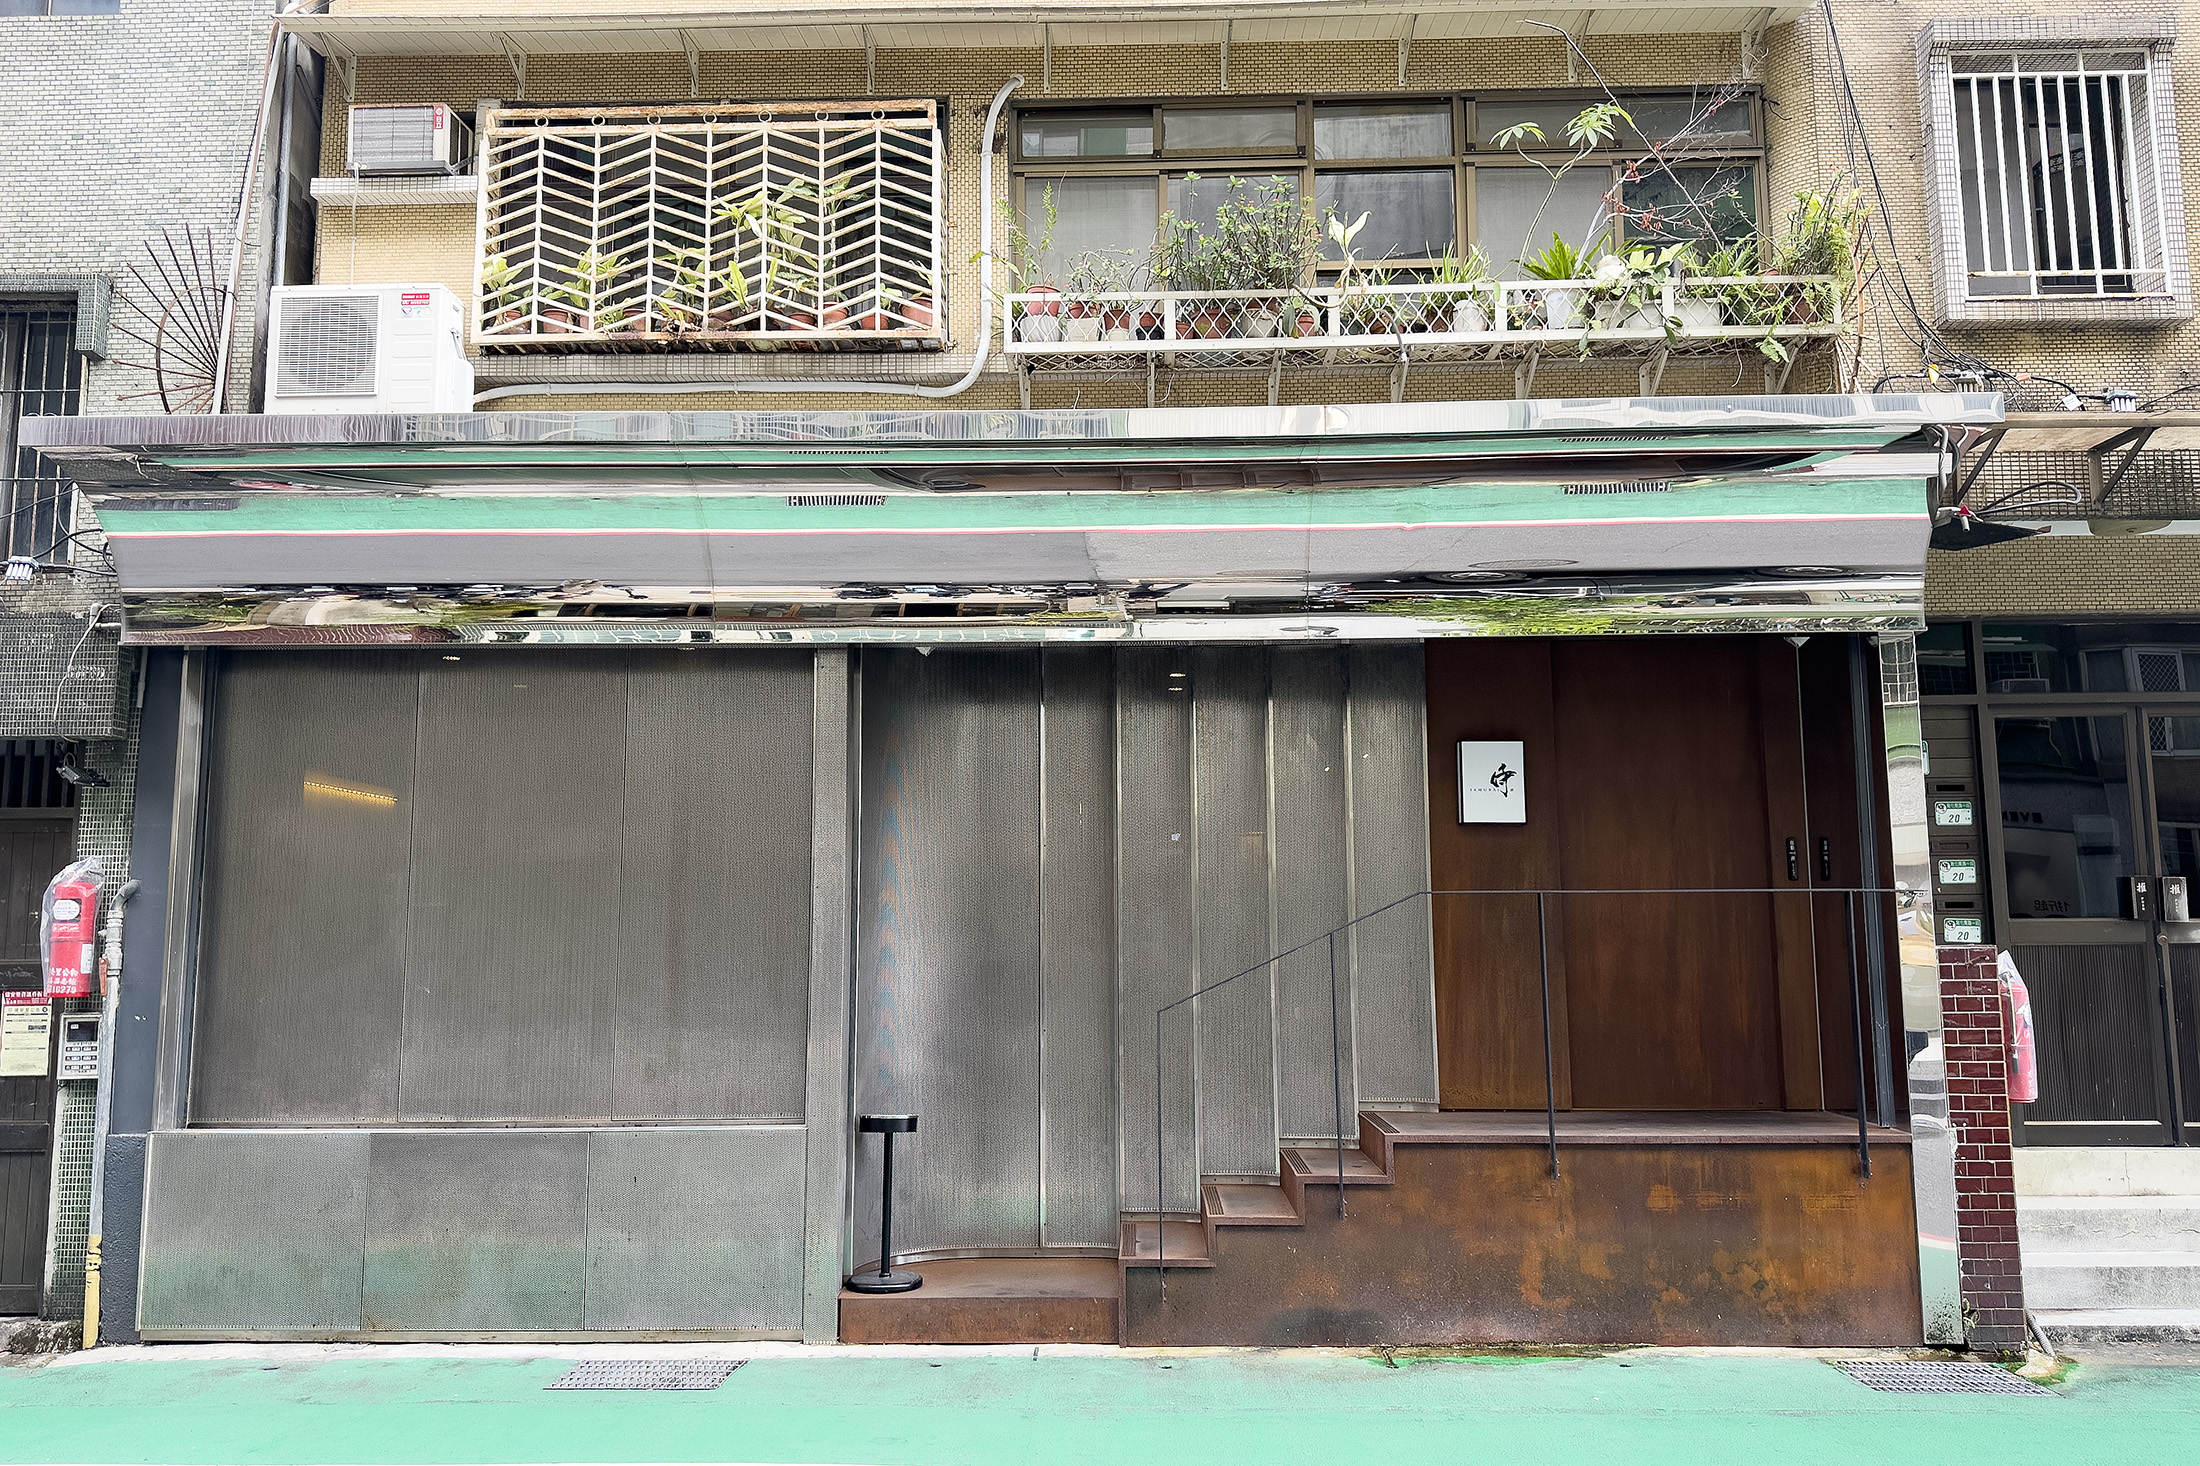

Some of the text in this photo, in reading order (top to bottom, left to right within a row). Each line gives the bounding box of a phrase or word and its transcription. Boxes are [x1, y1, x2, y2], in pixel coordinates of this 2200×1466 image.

[1948, 813, 1961, 823] 20
[1952, 872, 1965, 882] 20
[2136, 882, 2147, 893] 推
[2169, 884, 2181, 895] 推
[1957, 931, 1970, 941] 20
